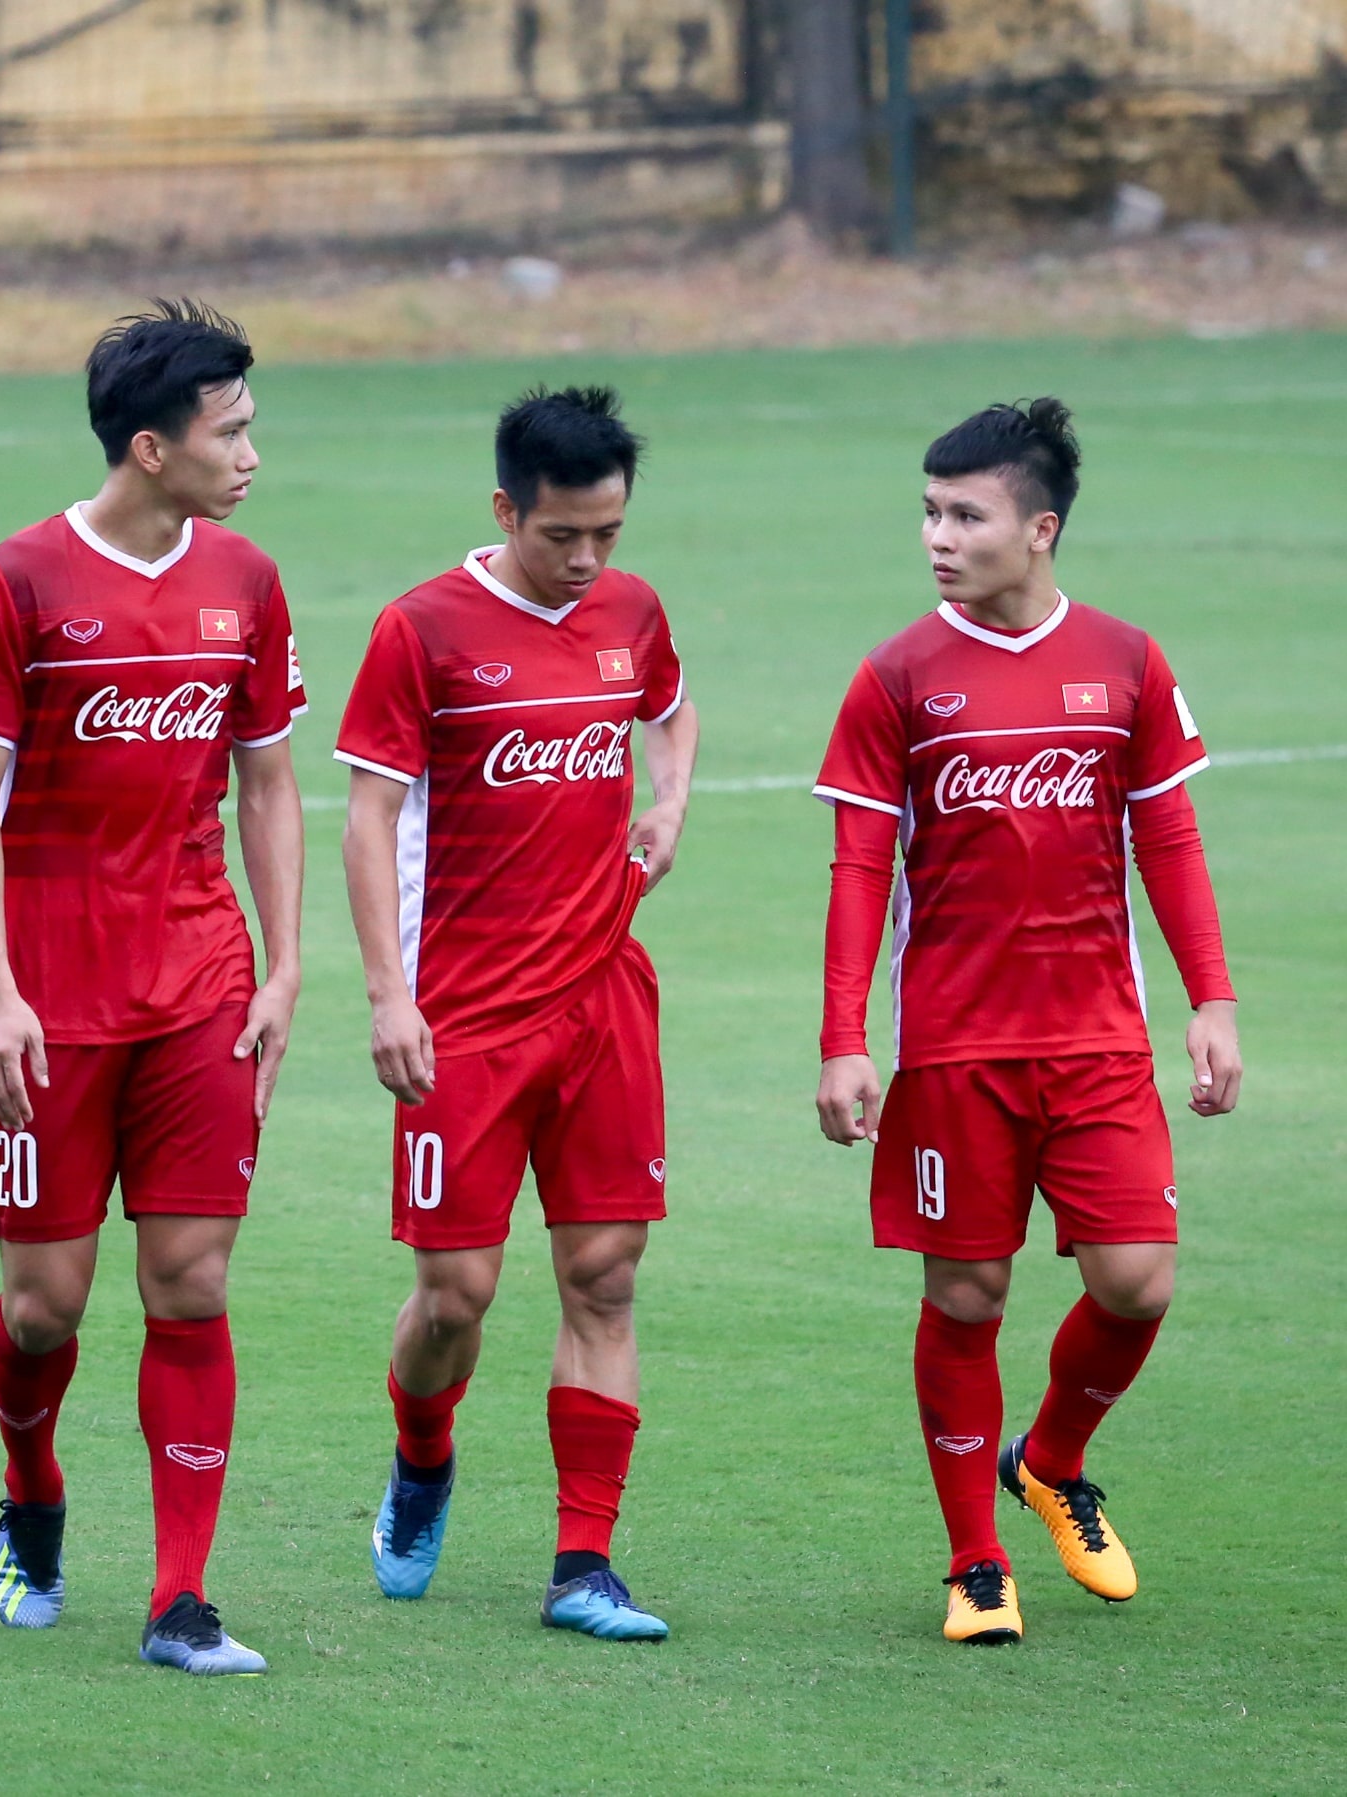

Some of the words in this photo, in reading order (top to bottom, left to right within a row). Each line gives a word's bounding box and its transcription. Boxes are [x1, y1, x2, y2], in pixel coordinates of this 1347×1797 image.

[74, 681, 232, 743] Coca-Cola
[482, 719, 632, 788] Coca-Cola
[934, 747, 1107, 815] Coca-Cola
[404, 1131, 443, 1210] 10
[914, 1146, 945, 1221] 19
